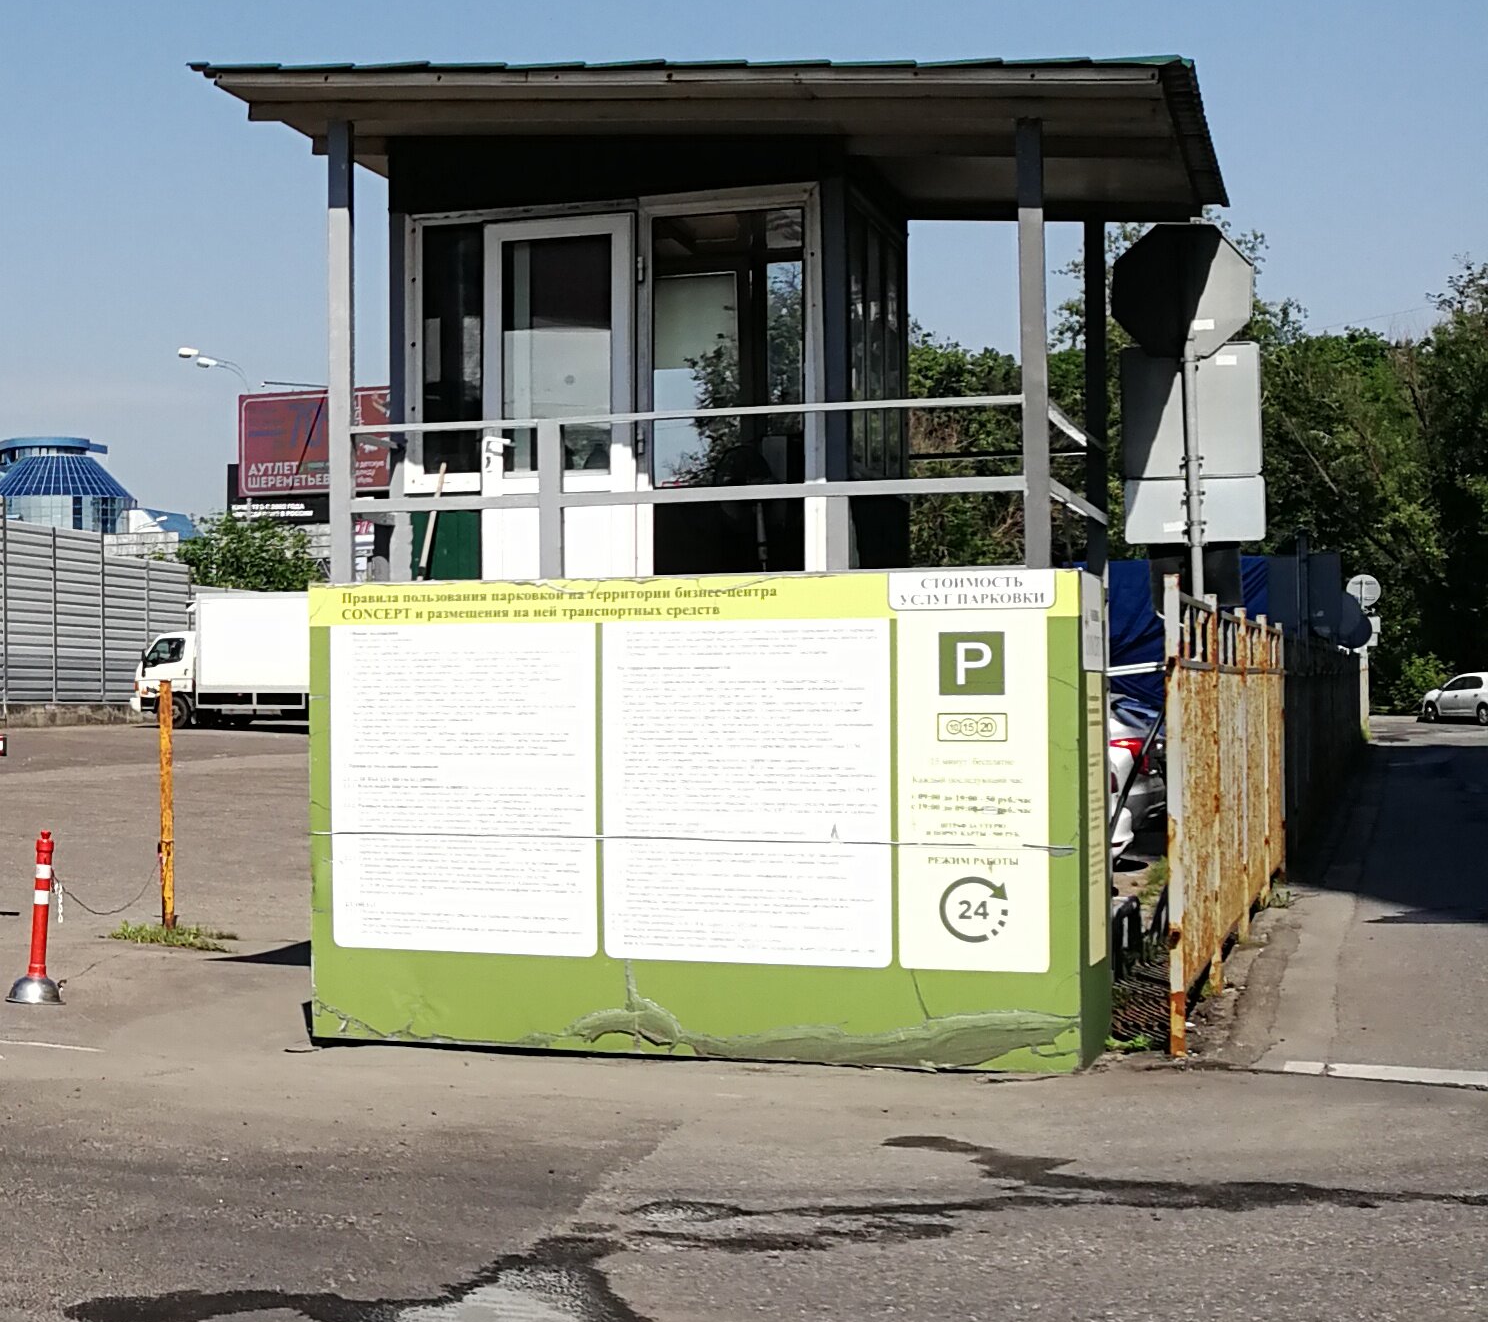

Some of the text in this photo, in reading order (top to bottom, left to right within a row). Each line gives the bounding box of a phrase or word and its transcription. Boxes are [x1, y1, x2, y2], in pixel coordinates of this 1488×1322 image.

[247, 461, 299, 476] АУТЛЕТ
[920, 576, 1024, 590] СТОИМОСТЬ
[341, 586, 778, 604] Правила пользования парковкой на территории бизнес-центра
[900, 592, 1046, 606] УСЛУГ ПАРКОВКИ
[341, 605, 721, 623] CONCEPT и размещения на ней транспортных средств
[955, 641, 993, 686] P
[963, 722, 975, 732] 15
[979, 721, 994, 733] 20
[927, 856, 1020, 867] РЕЖИМ РАБОТЫ
[958, 899, 990, 920] 24
